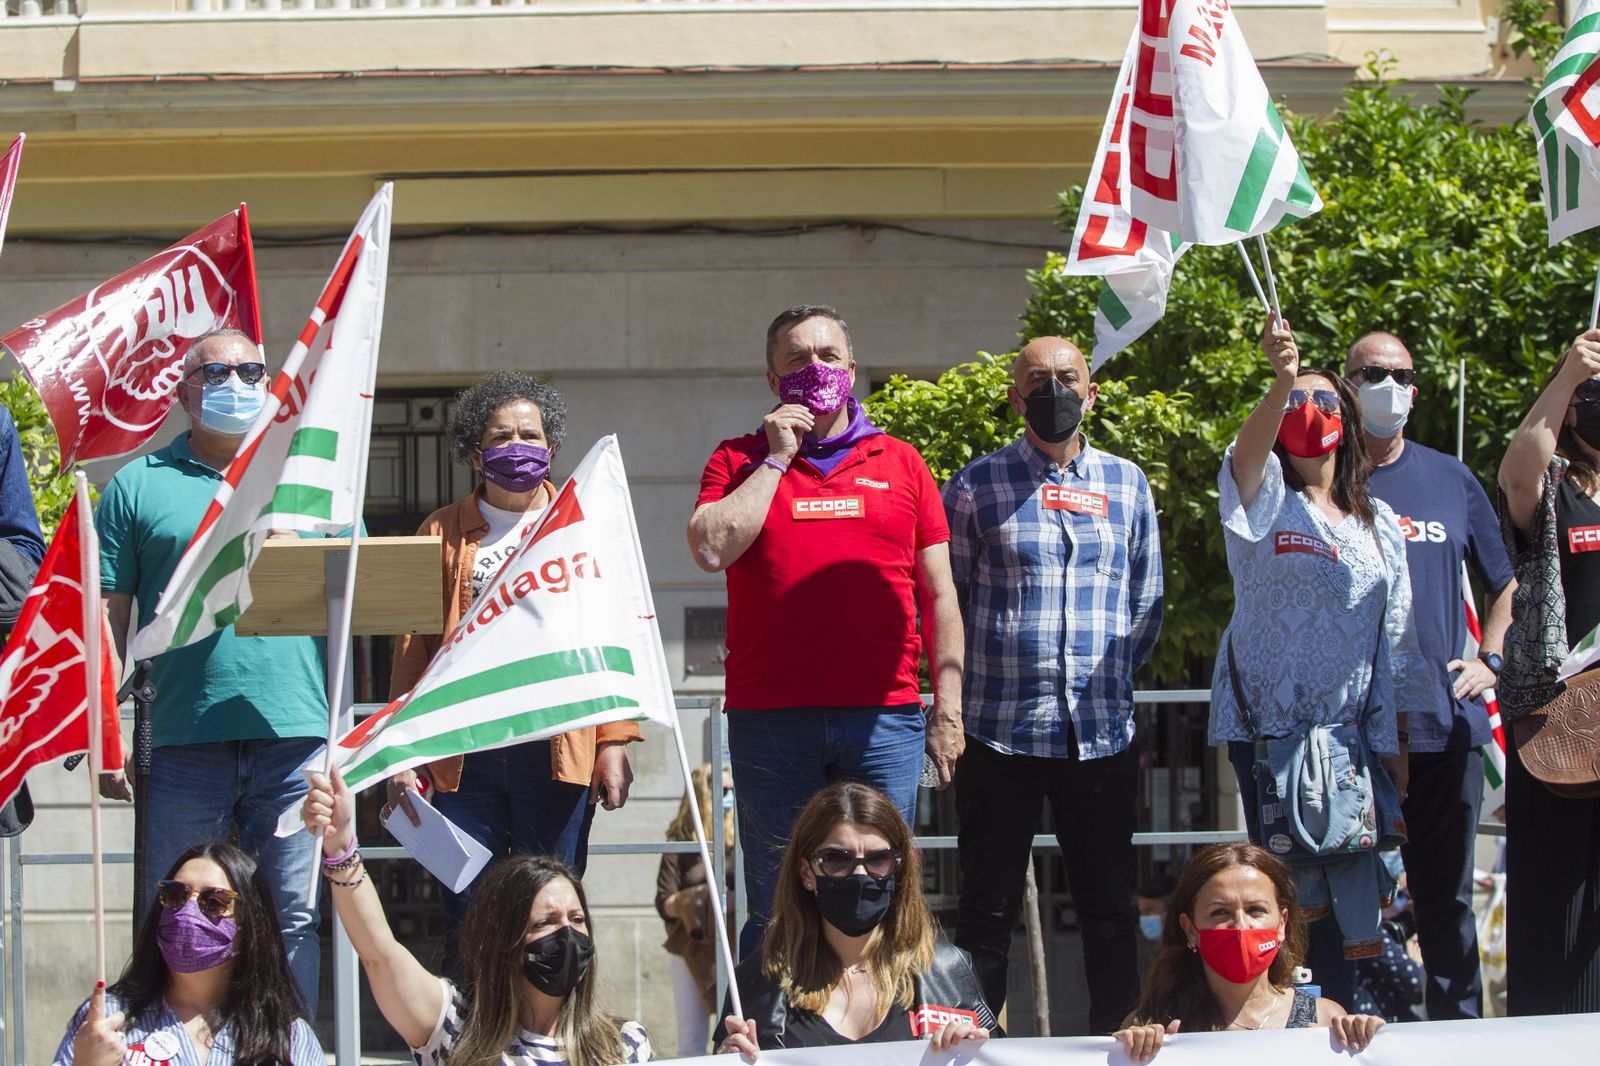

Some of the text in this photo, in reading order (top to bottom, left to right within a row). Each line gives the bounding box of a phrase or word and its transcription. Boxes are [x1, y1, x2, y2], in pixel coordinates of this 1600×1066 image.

[1046, 489, 1092, 506] CCOO
[796, 500, 847, 512] CCOO
[1278, 534, 1324, 550] CCOO
